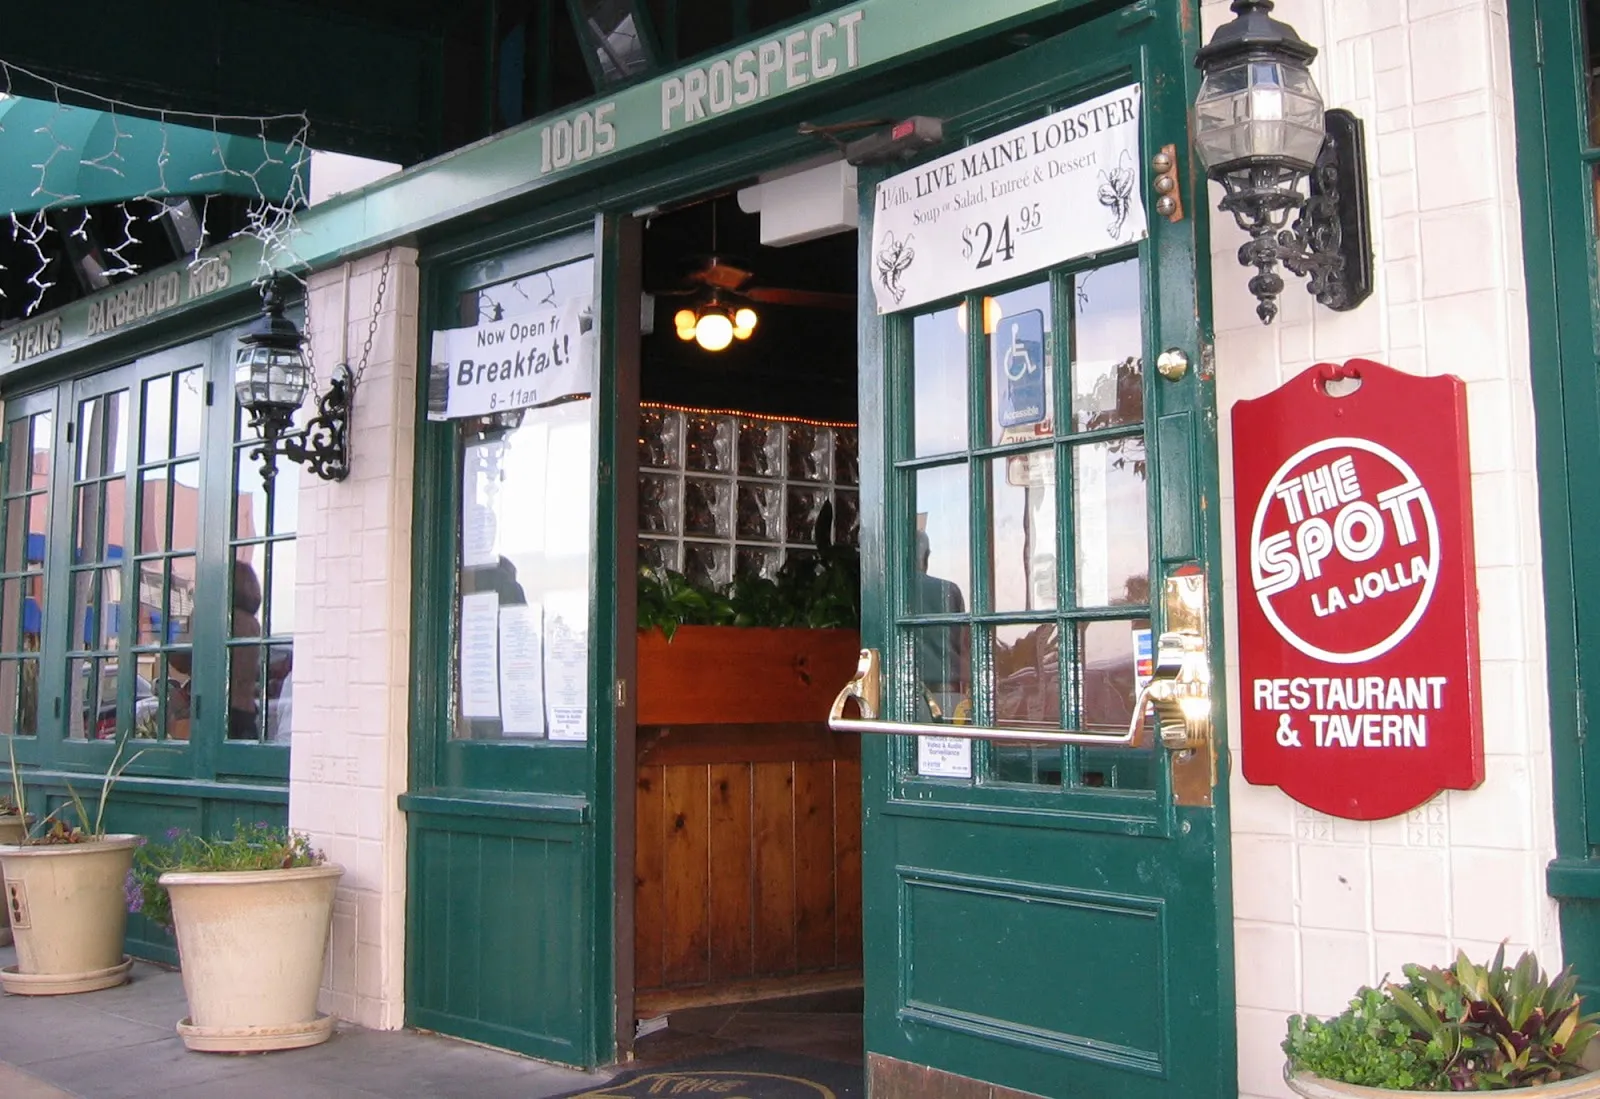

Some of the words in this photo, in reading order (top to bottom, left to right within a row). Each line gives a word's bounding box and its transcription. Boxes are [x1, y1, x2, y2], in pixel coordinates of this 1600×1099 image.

[541, 103, 616, 174] 1005
[661, 10, 864, 131] PROSPECT
[915, 163, 957, 199] LIVE
[961, 136, 1027, 181] MAINE
[1032, 97, 1135, 155] LOBSTER
[913, 207, 940, 227] Soup
[954, 189, 988, 212] Salad,
[1033, 168, 1044, 182] &
[1048, 151, 1098, 179] Dessert
[11, 318, 61, 363] STEAKS
[457, 334, 570, 386] Breakfat!
[477, 329, 505, 348] Now
[510, 322, 545, 343] Open
[1003, 406, 1039, 420] Accessible
[1276, 455, 1361, 523] THE
[1256, 486, 1425, 594] SPOT
[1311, 588, 1347, 618] LA
[1349, 557, 1429, 604] JOLLA
[1254, 676, 1447, 711] RESTAURANT
[1276, 716, 1301, 747] &
[1310, 714, 1427, 748] TAVERN
